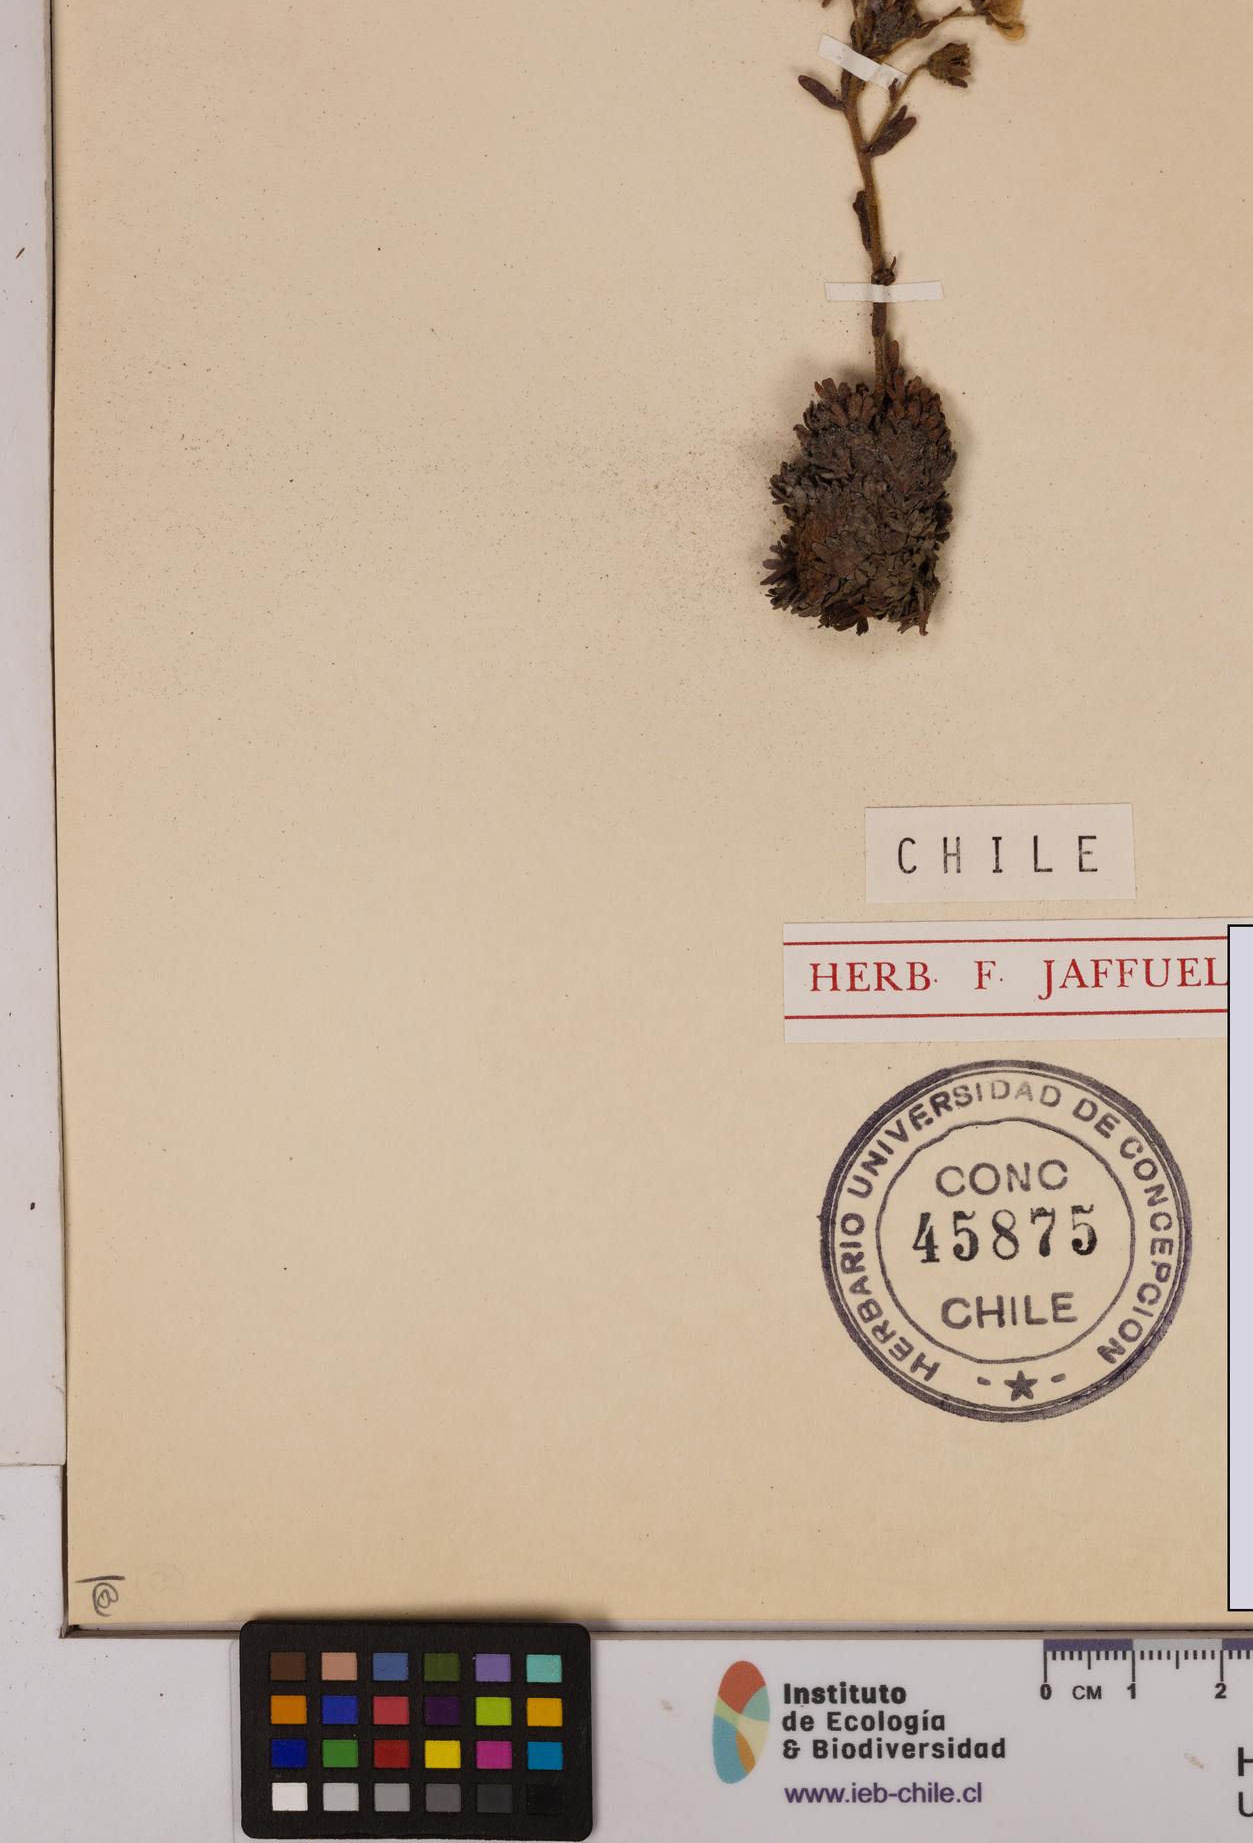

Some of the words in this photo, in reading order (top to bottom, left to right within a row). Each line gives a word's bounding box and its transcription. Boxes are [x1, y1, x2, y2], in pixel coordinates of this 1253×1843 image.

[898, 836, 1097, 874] CHILE
[1037, 957, 1229, 1001] JAFFUEL
[1071, 1095, 1122, 1140] DE
[846, 1077, 1064, 1200] UNIVERSIDAD
[935, 1158, 1070, 1198] CONC
[911, 1204, 1100, 1265] 45875
[1094, 1134, 1177, 1367] CONCEPCION
[940, 1290, 1079, 1332] CHILE
[784, 1682, 906, 1704] Instituto
[1038, 1682, 1052, 1702] 0
[1073, 1686, 1101, 1700] CM
[1127, 1680, 1136, 1699] 1
[1215, 1683, 1226, 1699] 2
[782, 1711, 814, 1731] de
[827, 1710, 944, 1735] Ecología
[783, 1739, 800, 1759] &
[813, 1737, 1005, 1759] Biodiversidad
[785, 1782, 981, 1803] www.ieb-chile.cl
